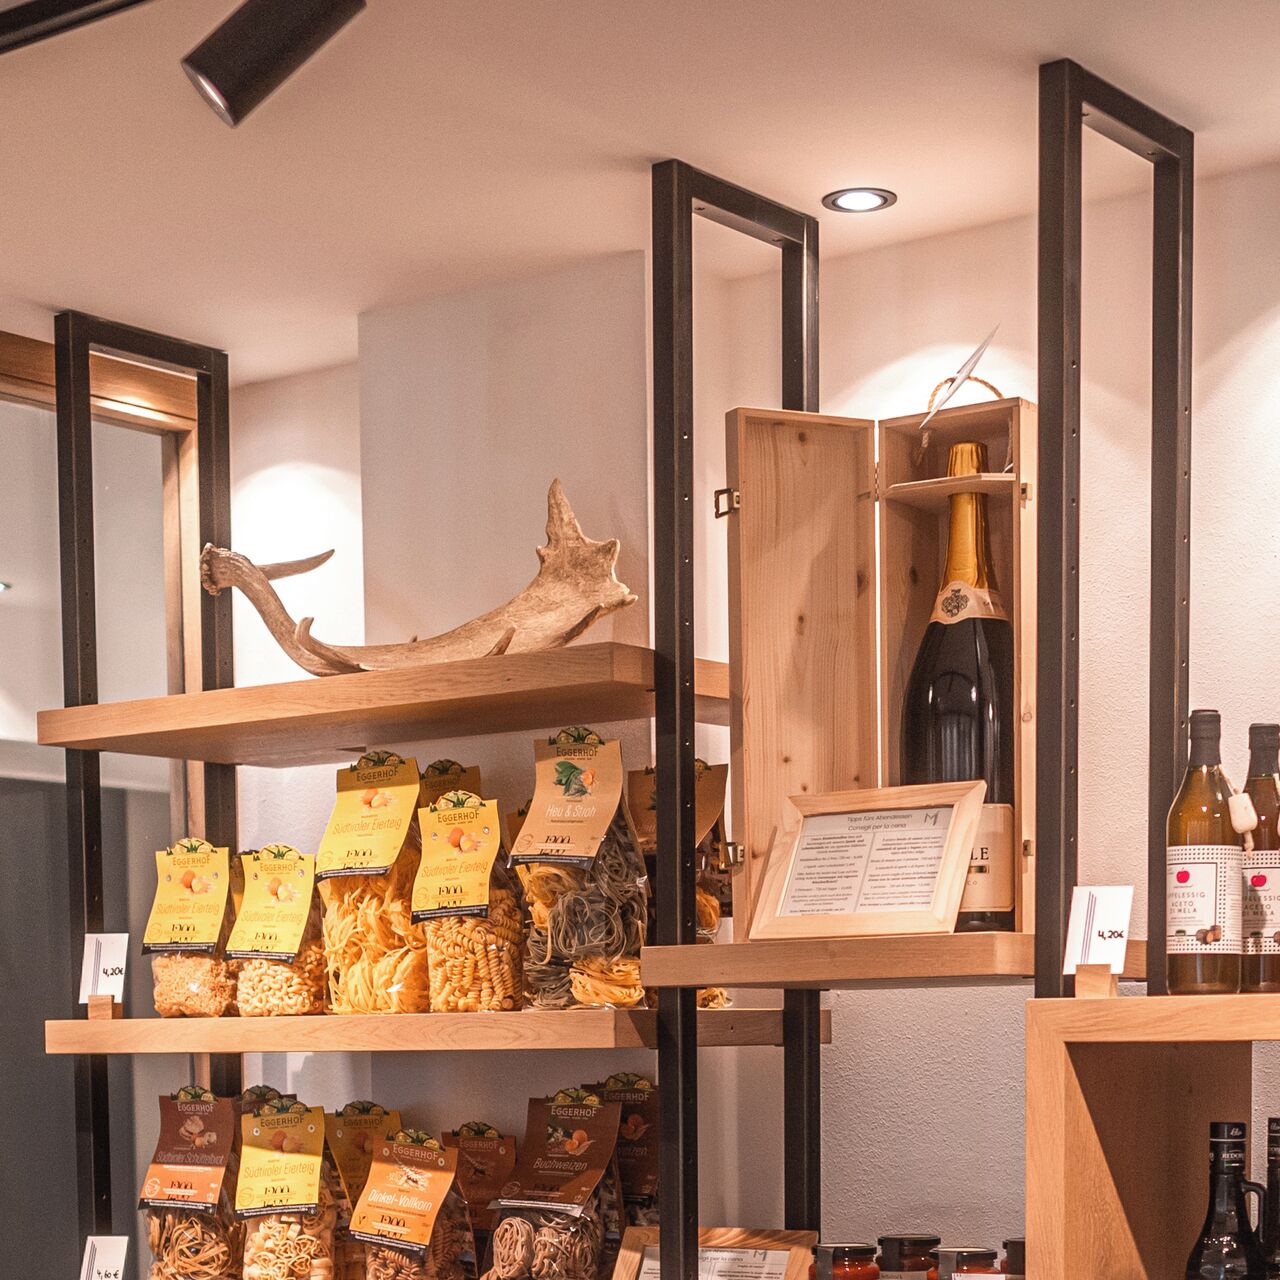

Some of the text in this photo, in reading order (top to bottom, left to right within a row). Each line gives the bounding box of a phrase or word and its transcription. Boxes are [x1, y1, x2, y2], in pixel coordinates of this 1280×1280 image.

[556, 747, 599, 757] EGGERHOF
[356, 768, 399, 782] EGGERHOF
[438, 810, 480, 824] EGGERHOF
[546, 804, 597, 817] Heu & Stroh
[172, 855, 211, 866] EGGERHOF
[260, 862, 298, 873] EGGERHOF
[177, 1103, 214, 1113] EGGERHOF
[551, 1106, 597, 1117] EGGERHOF
[260, 1116, 305, 1128] EGGERHOF
[393, 1144, 438, 1160] EGGERHOF
[244, 1161, 315, 1179] Südtiroler Eierteig
[533, 1158, 588, 1171] Buchweizen
[368, 1189, 433, 1212] Dinkel-Vollkorn
